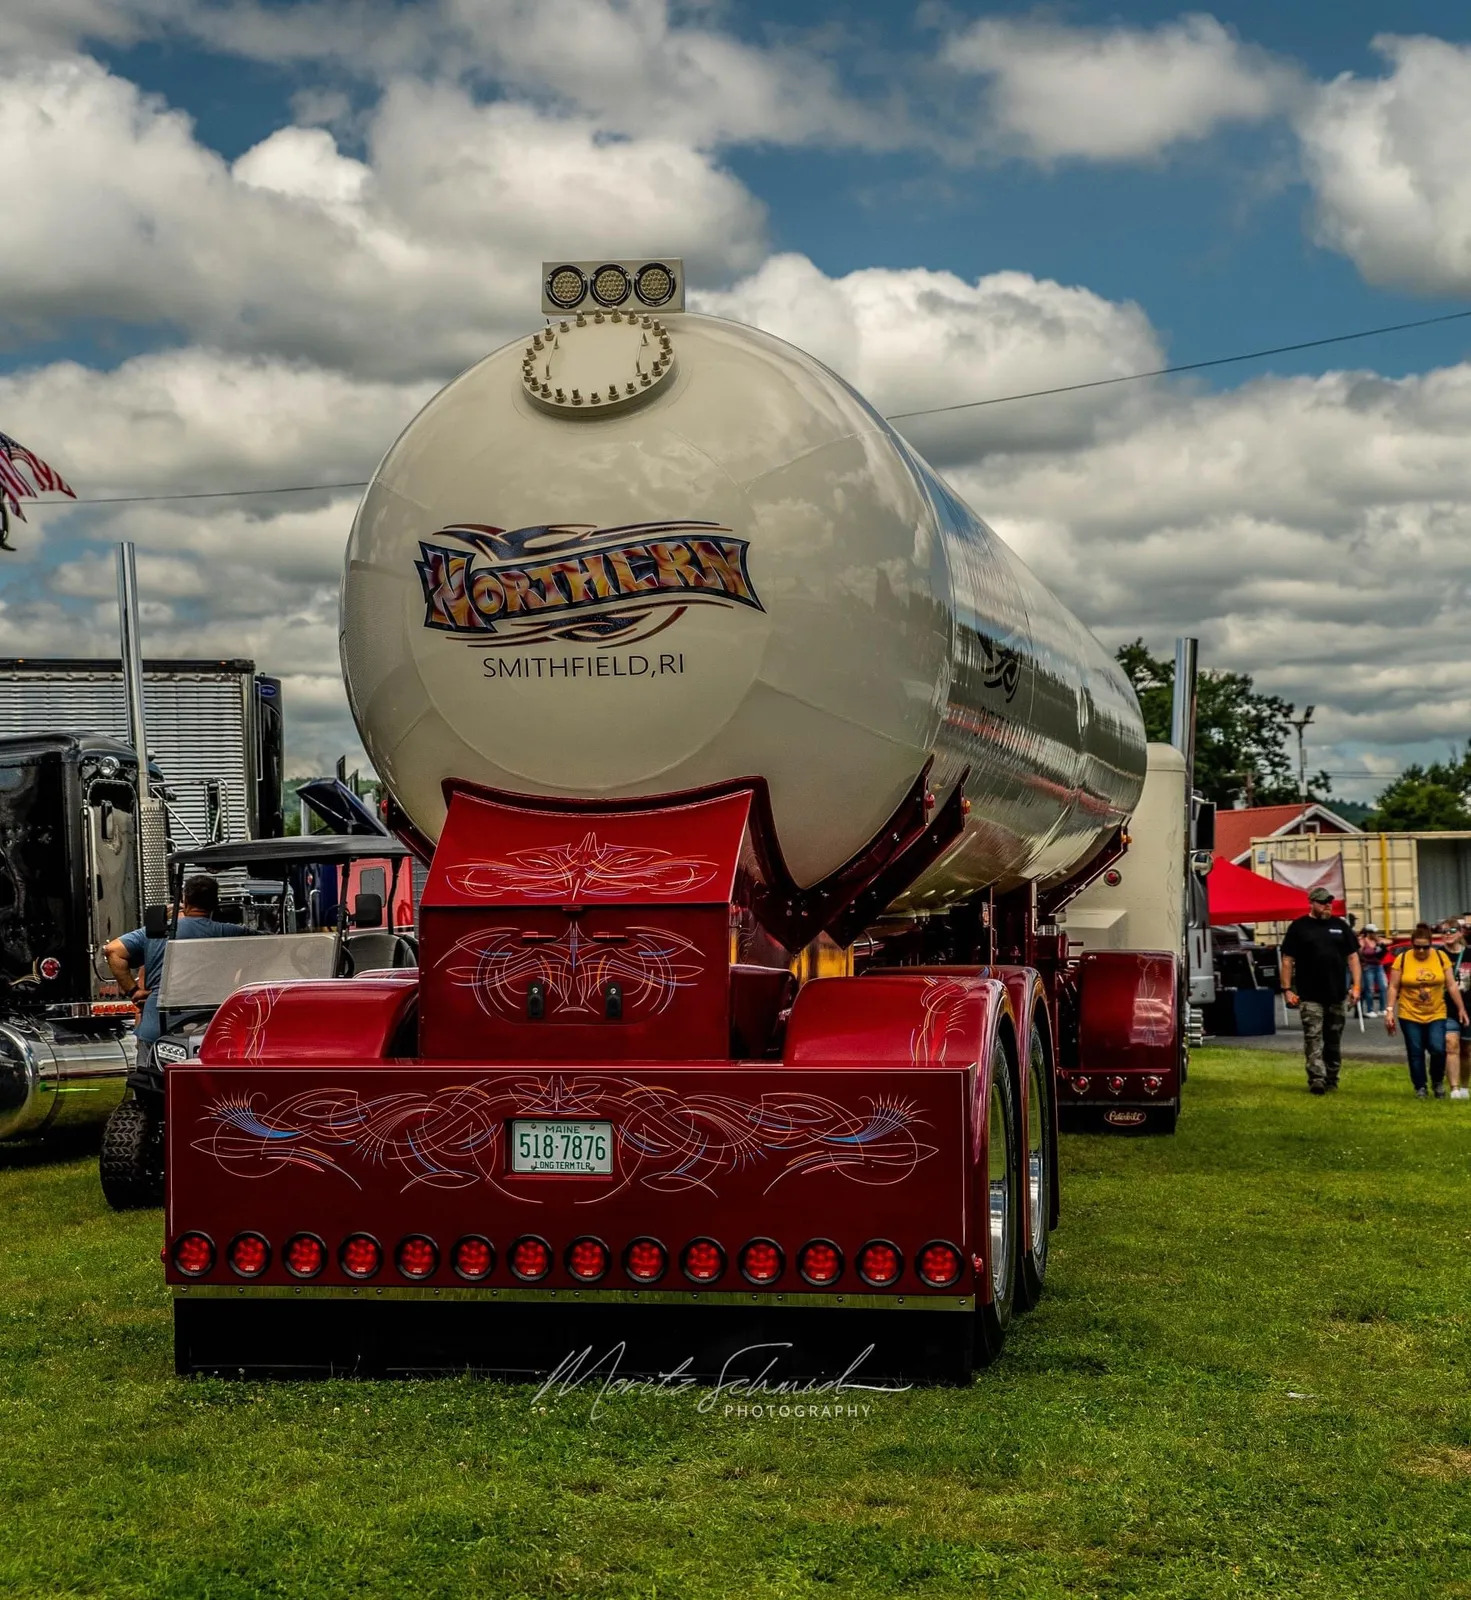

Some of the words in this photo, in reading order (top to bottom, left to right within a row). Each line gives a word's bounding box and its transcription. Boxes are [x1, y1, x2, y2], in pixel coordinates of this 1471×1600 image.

[414, 536, 767, 633] NORTHERN
[545, 1125, 581, 1134] MAINE
[534, 1161, 555, 1170] LONG
[555, 1161, 575, 1170] TERM
[576, 1161, 591, 1171] TLR
